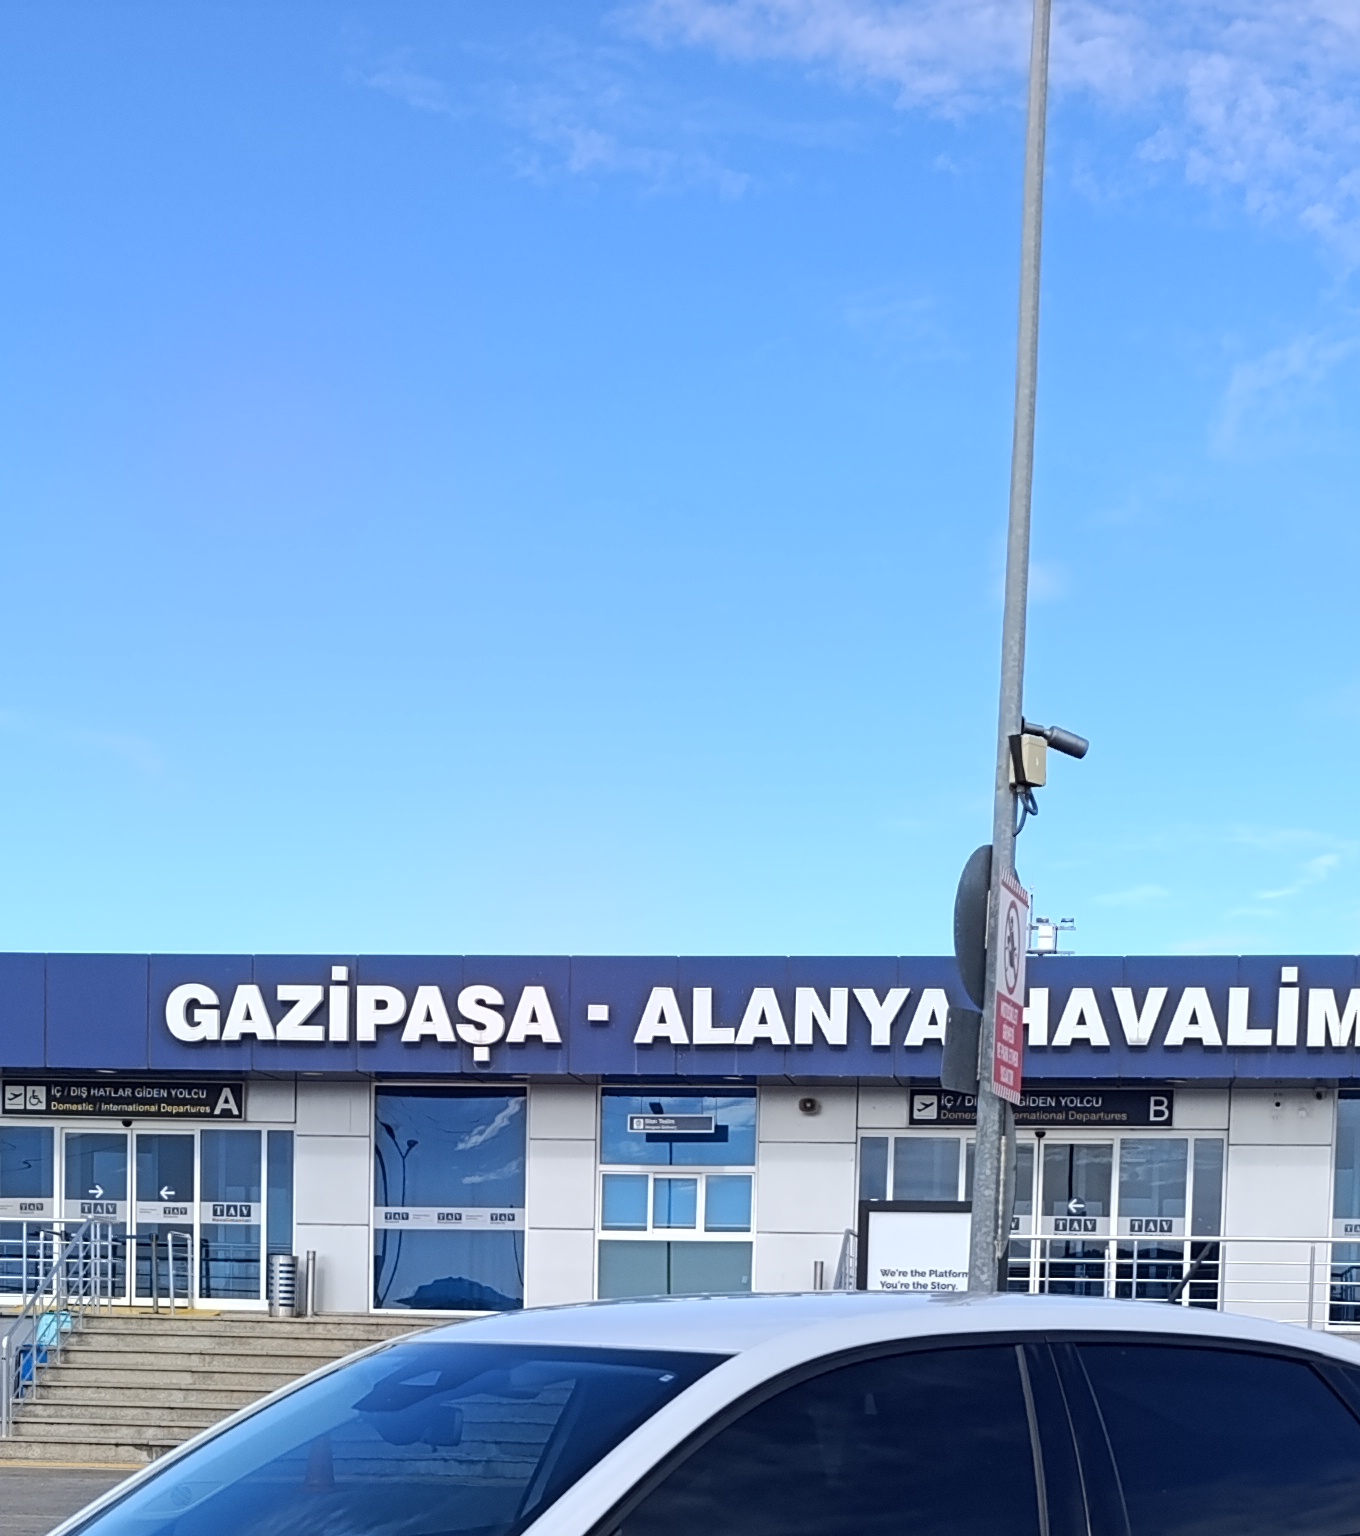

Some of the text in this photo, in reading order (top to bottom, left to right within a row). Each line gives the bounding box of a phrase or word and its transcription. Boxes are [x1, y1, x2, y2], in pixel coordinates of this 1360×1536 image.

[164, 965, 562, 1062] GAZİPAŞA
[634, 986, 944, 1047] ALANYA
[51, 1084, 62, 1099] İÇ
[70, 1086, 88, 1099] DIŞ
[90, 1087, 132, 1098] HATLAR
[135, 1085, 168, 1098] GİDEN
[170, 1088, 207, 1099] YOLCU
[51, 1101, 94, 1111] Domestic
[101, 1102, 158, 1112] International
[160, 1103, 211, 1114] Departures
[213, 1087, 240, 1115] A
[941, 1092, 954, 1109] İÇ
[1059, 1096, 1103, 1107] YOLCU
[1149, 1096, 1169, 1121] B
[1068, 1110, 1128, 1122] Departures
[80, 1202, 117, 1214] TAV
[212, 1204, 251, 1217] TAV
[1054, 1218, 1097, 1232] TAV
[1130, 1219, 1173, 1233] TAV
[880, 1269, 908, 1277] We're
[910, 1269, 927, 1277] the
[880, 1281, 958, 1291] You're the Story.
